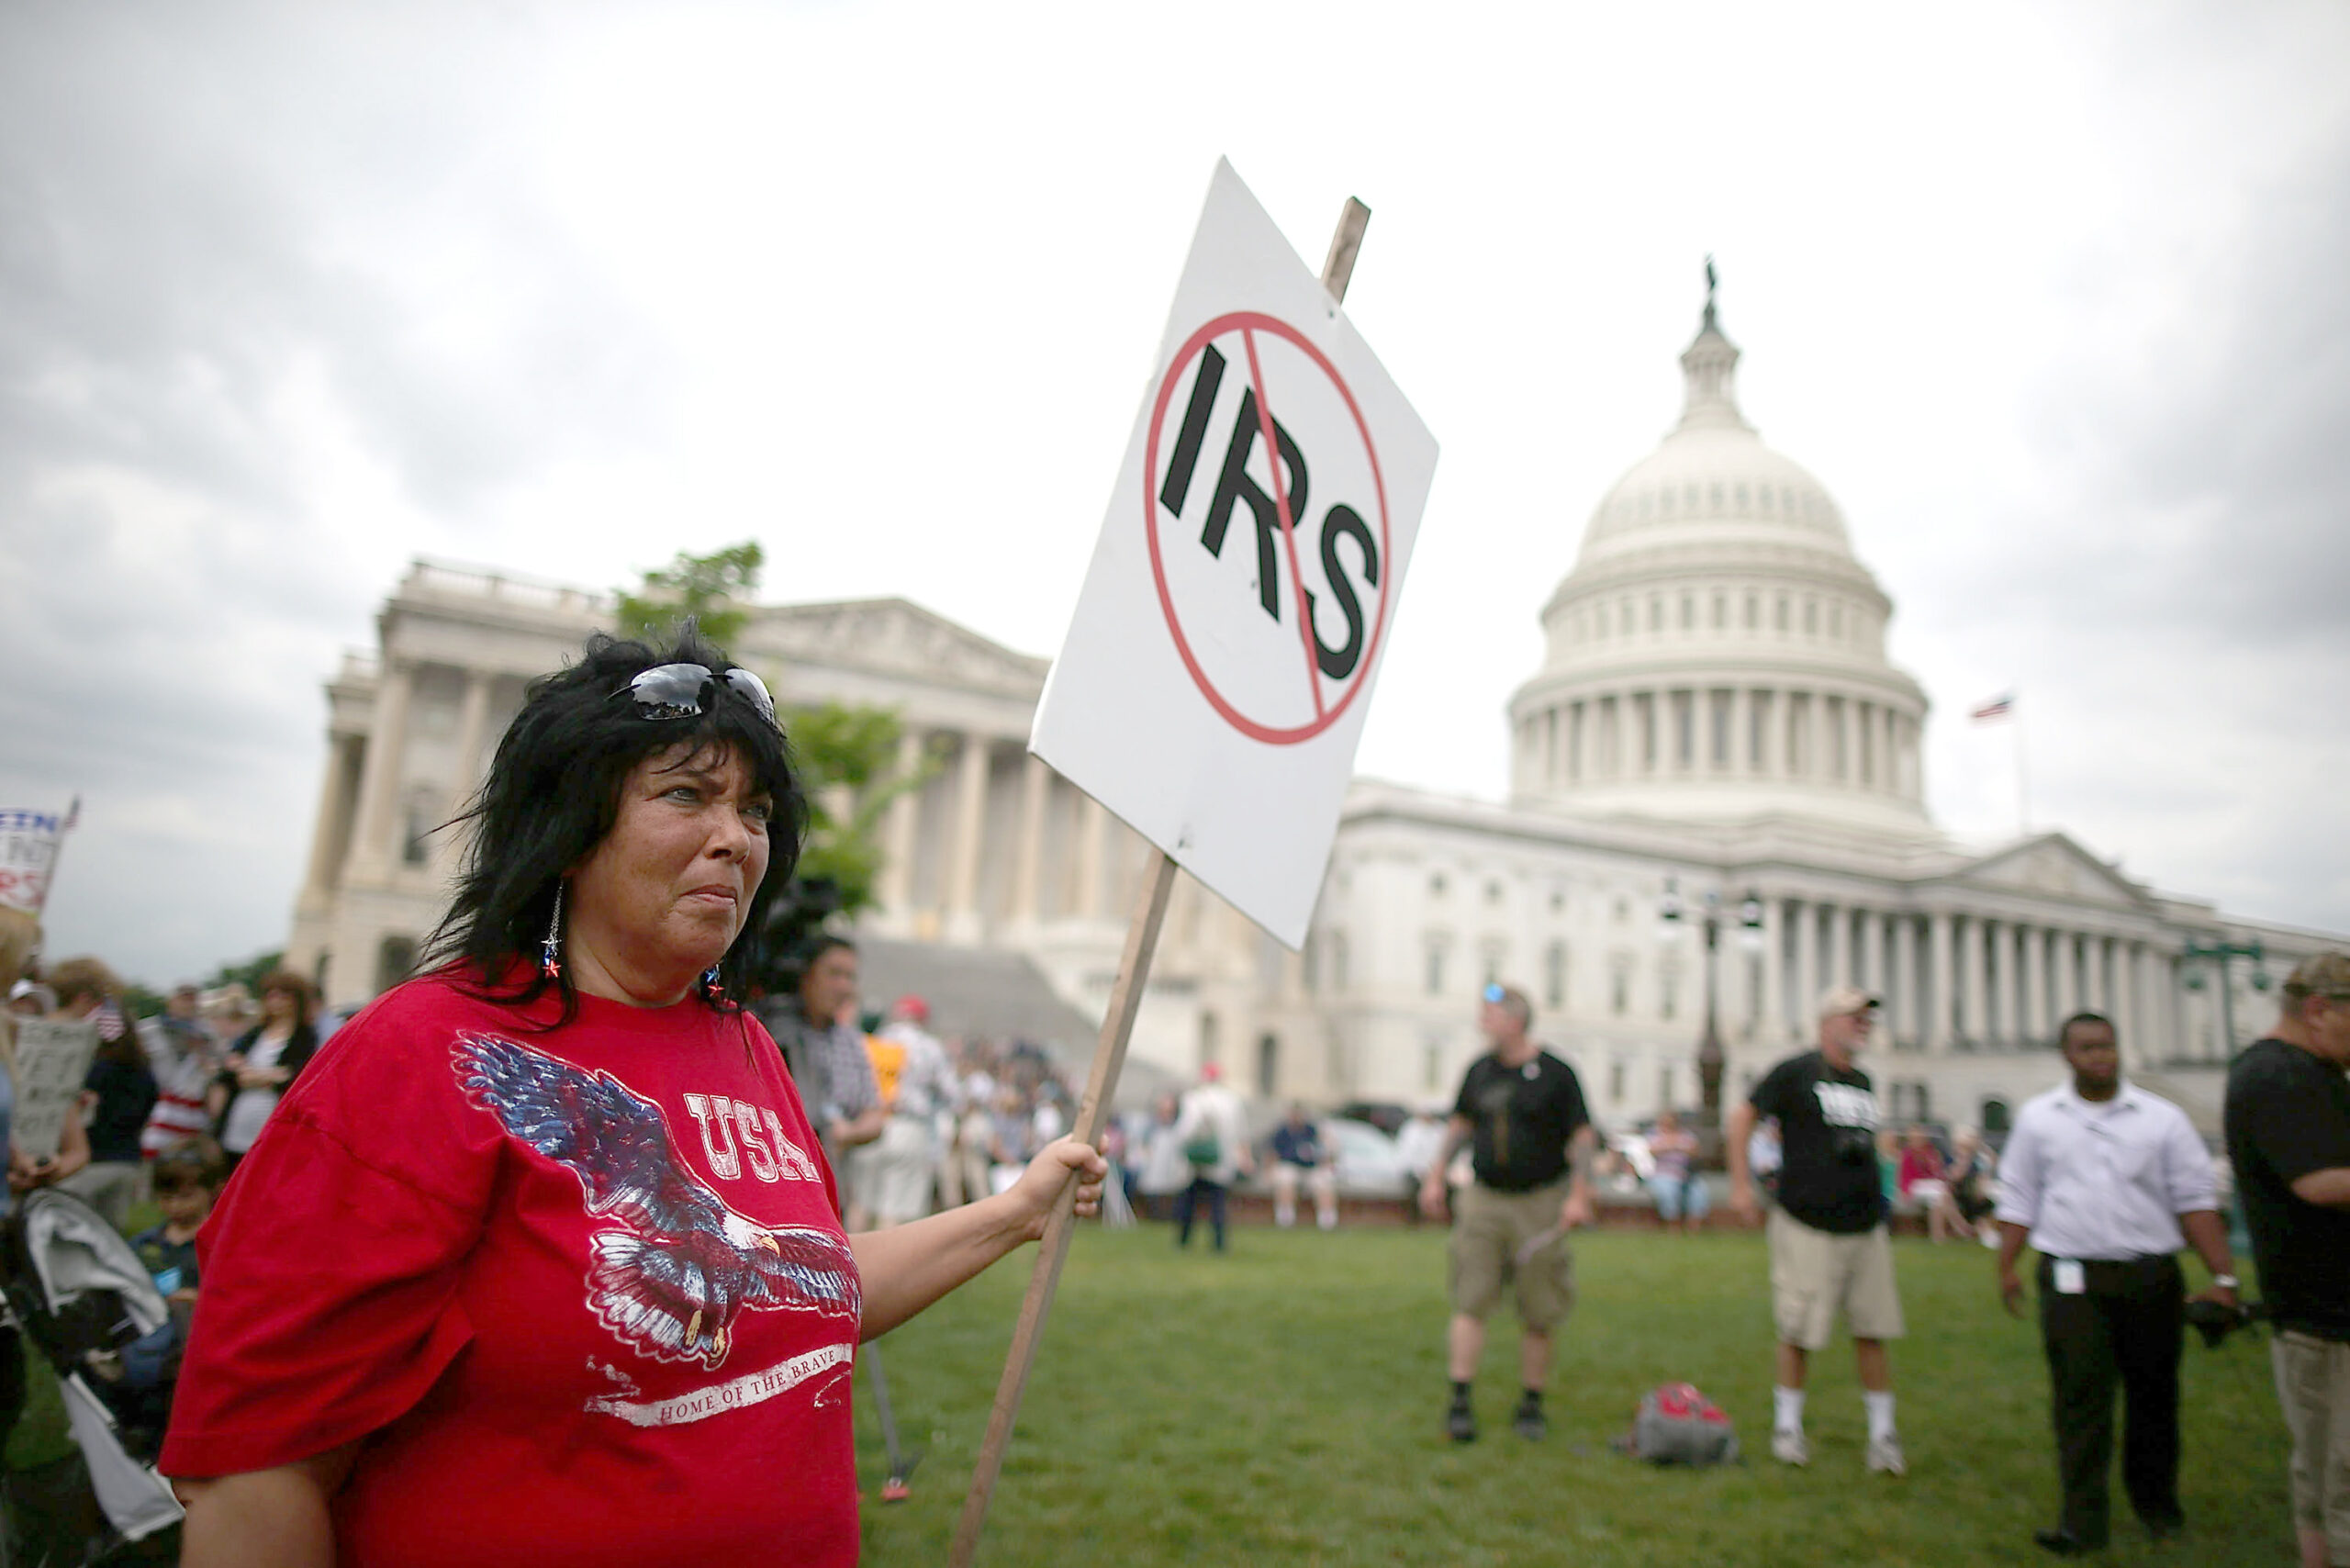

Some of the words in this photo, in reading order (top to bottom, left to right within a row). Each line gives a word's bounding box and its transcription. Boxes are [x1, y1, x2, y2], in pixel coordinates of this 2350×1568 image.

[1159, 342, 1380, 679] IRS
[683, 1092, 822, 1184] USA
[660, 1394, 714, 1422] HOME
[722, 1385, 744, 1405] OF
[751, 1373, 787, 1395] THE
[791, 1350, 835, 1379] BRAVE
